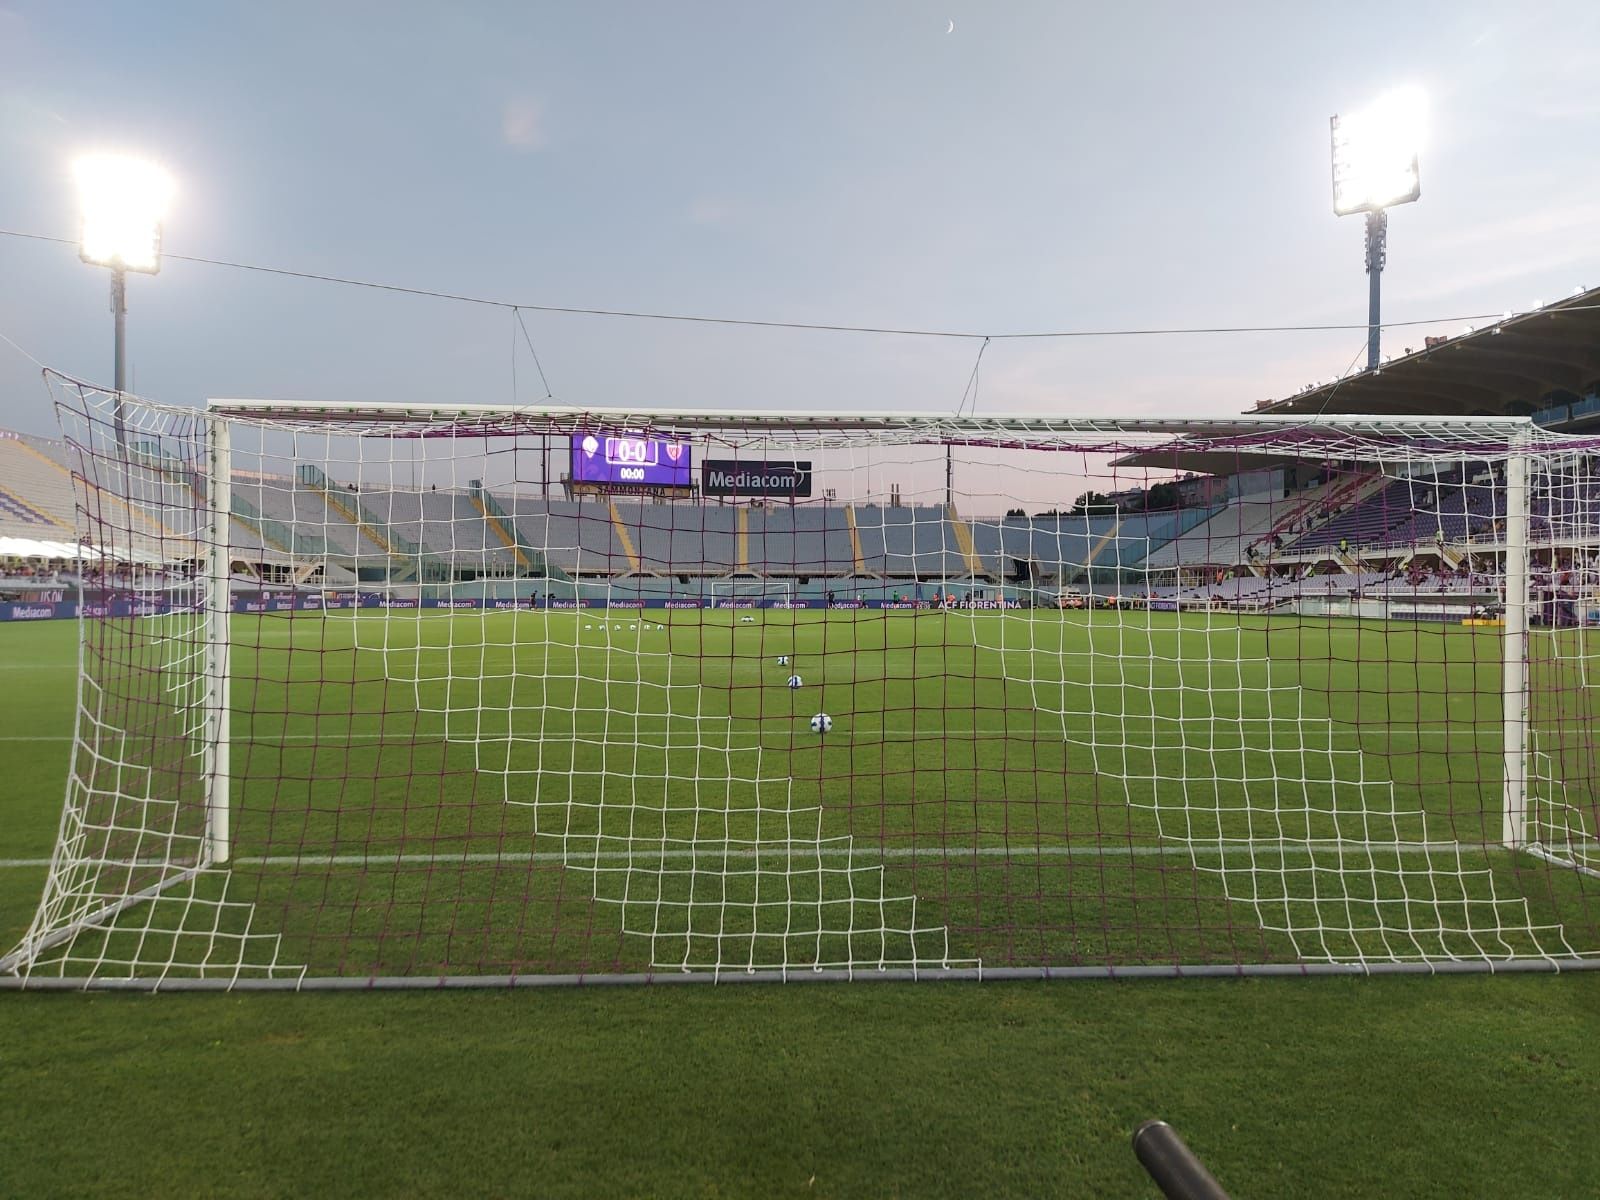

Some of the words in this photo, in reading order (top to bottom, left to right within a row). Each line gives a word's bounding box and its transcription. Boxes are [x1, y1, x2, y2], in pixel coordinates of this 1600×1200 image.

[619, 440, 647, 461] 0-0
[620, 467, 645, 480] 00:00
[708, 470, 796, 488] Mediacom
[597, 484, 667, 497] SAMMONTANA
[664, 600, 697, 608] Mediacom
[937, 601, 957, 609] ACF
[959, 601, 1022, 609] FIORENTINA
[12, 605, 52, 618] Mediacom
